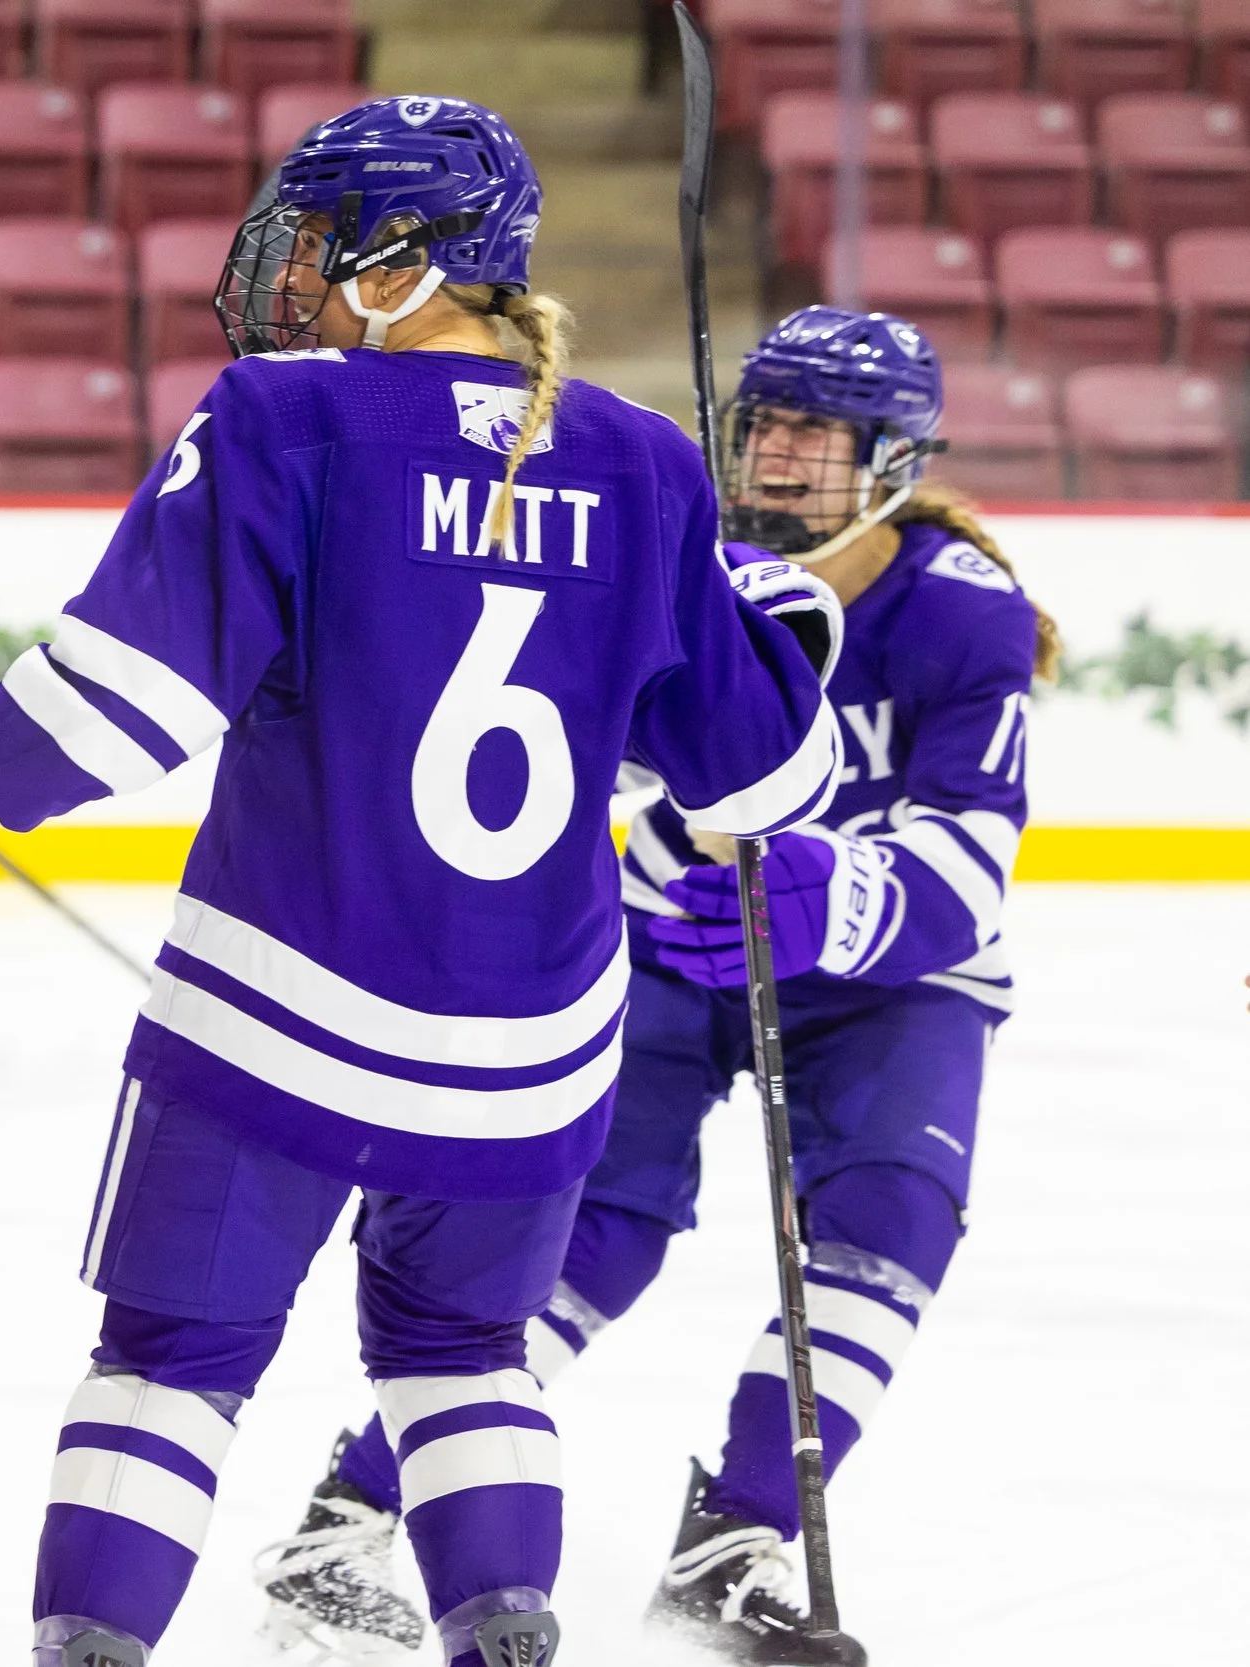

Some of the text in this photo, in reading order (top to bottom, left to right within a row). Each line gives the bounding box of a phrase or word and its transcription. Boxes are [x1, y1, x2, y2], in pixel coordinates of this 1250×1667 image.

[362, 161, 434, 173] BAUER
[355, 239, 409, 272] BAUER
[156, 411, 213, 499] 6
[420, 471, 601, 569] MATT
[411, 581, 576, 882] 6
